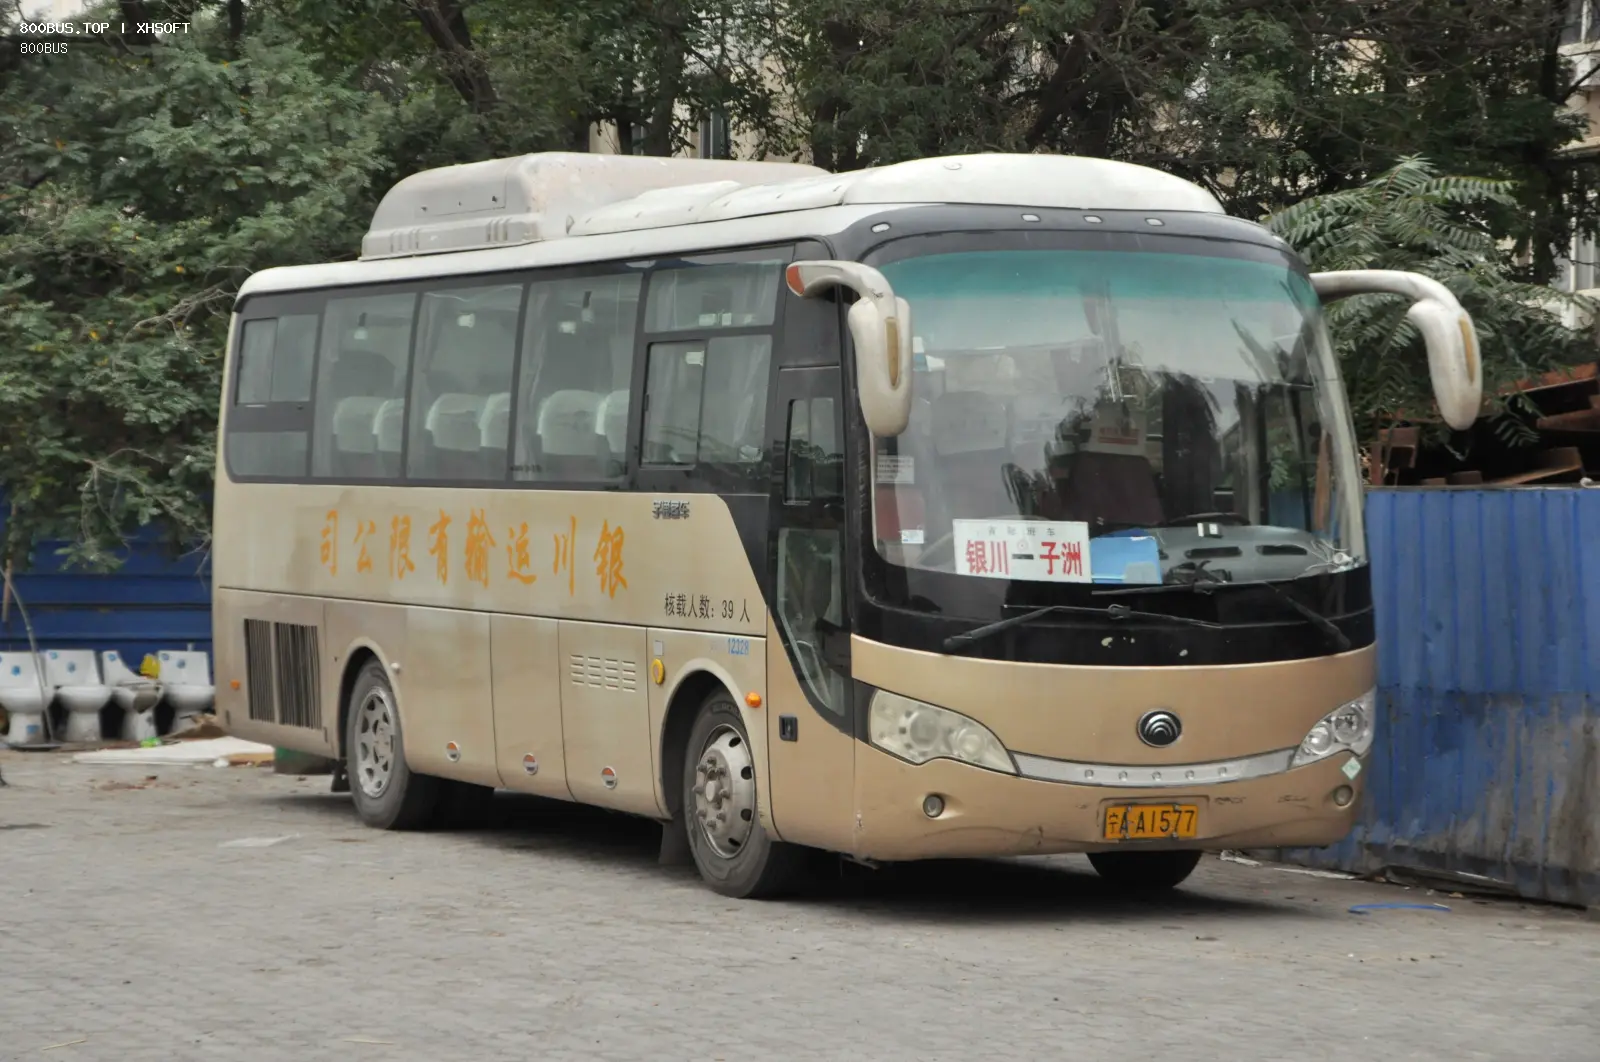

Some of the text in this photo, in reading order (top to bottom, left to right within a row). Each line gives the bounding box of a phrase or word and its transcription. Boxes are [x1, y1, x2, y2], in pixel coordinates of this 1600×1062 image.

[721, 599, 734, 619] 39
[739, 598, 751, 623] 人
[727, 637, 750, 656] 12328
